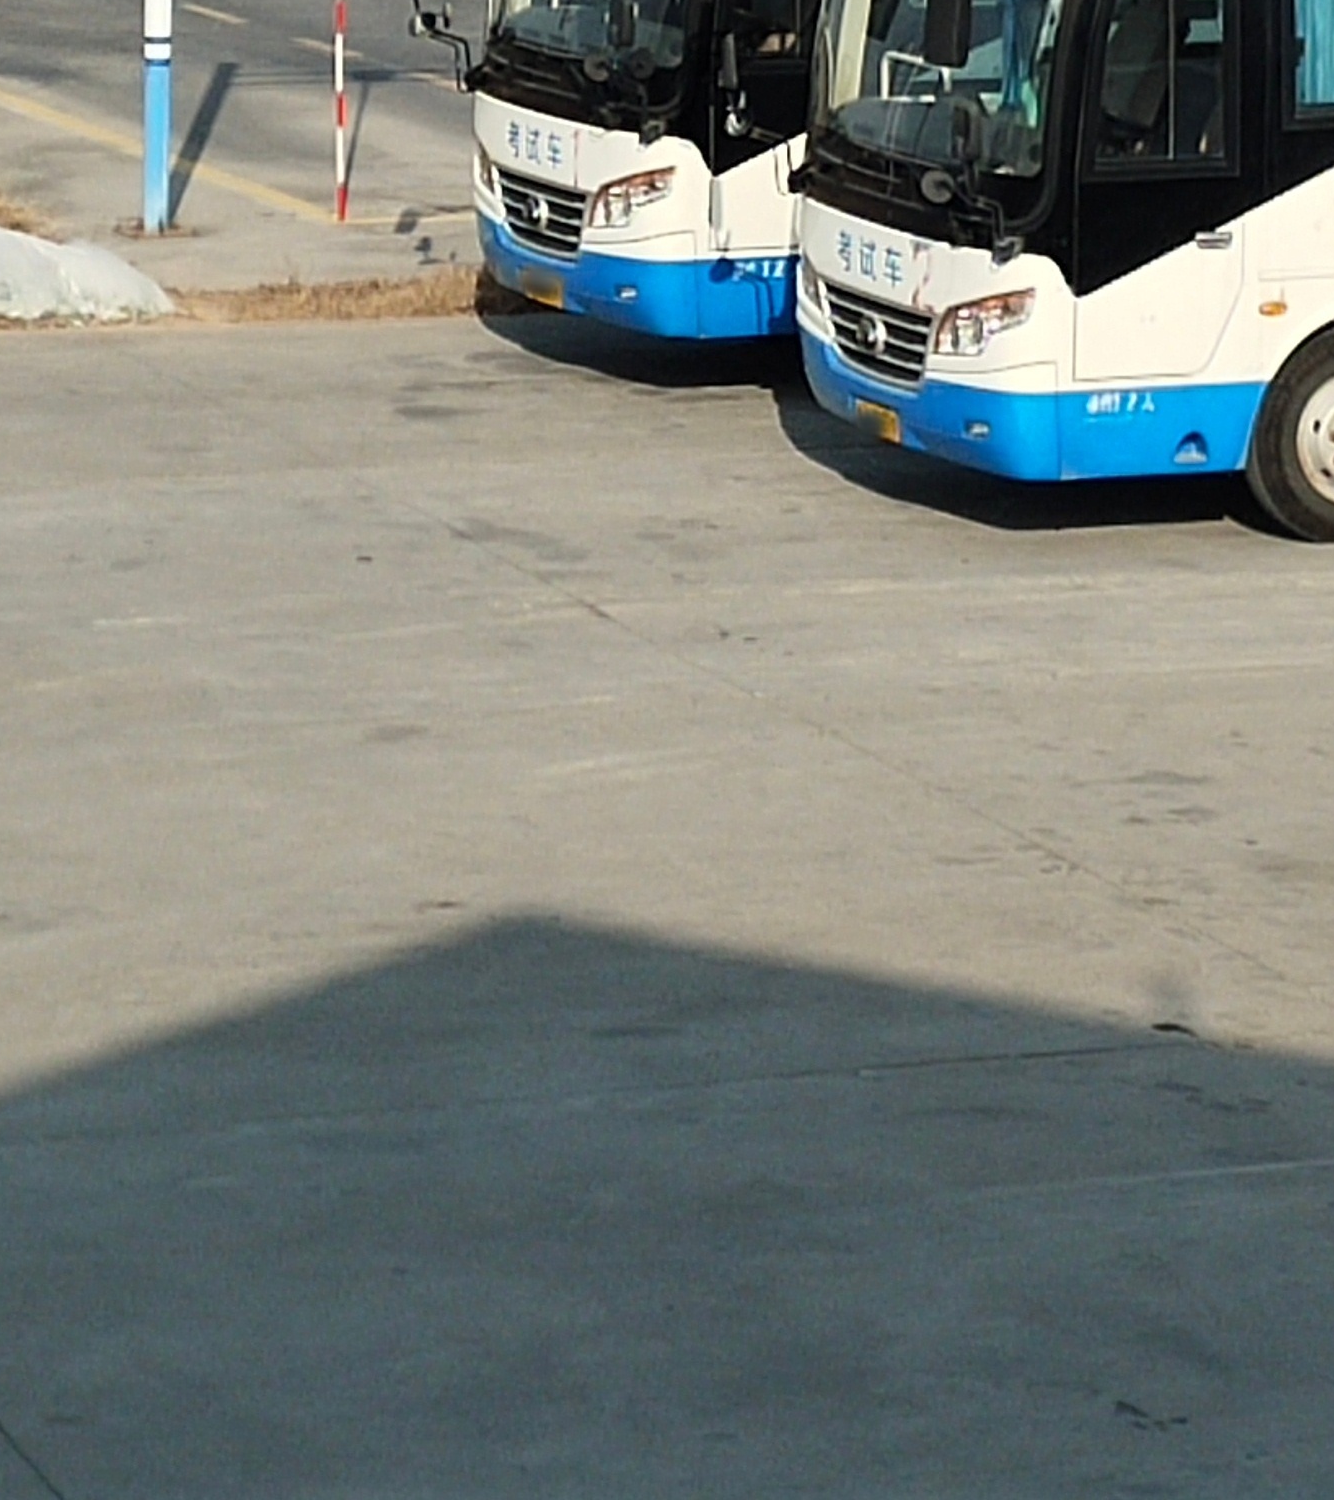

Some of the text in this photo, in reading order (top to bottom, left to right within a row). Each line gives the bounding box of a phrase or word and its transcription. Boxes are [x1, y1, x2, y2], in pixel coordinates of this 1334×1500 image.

[507, 119, 562, 169] 考试车
[836, 230, 904, 289] 考试车
